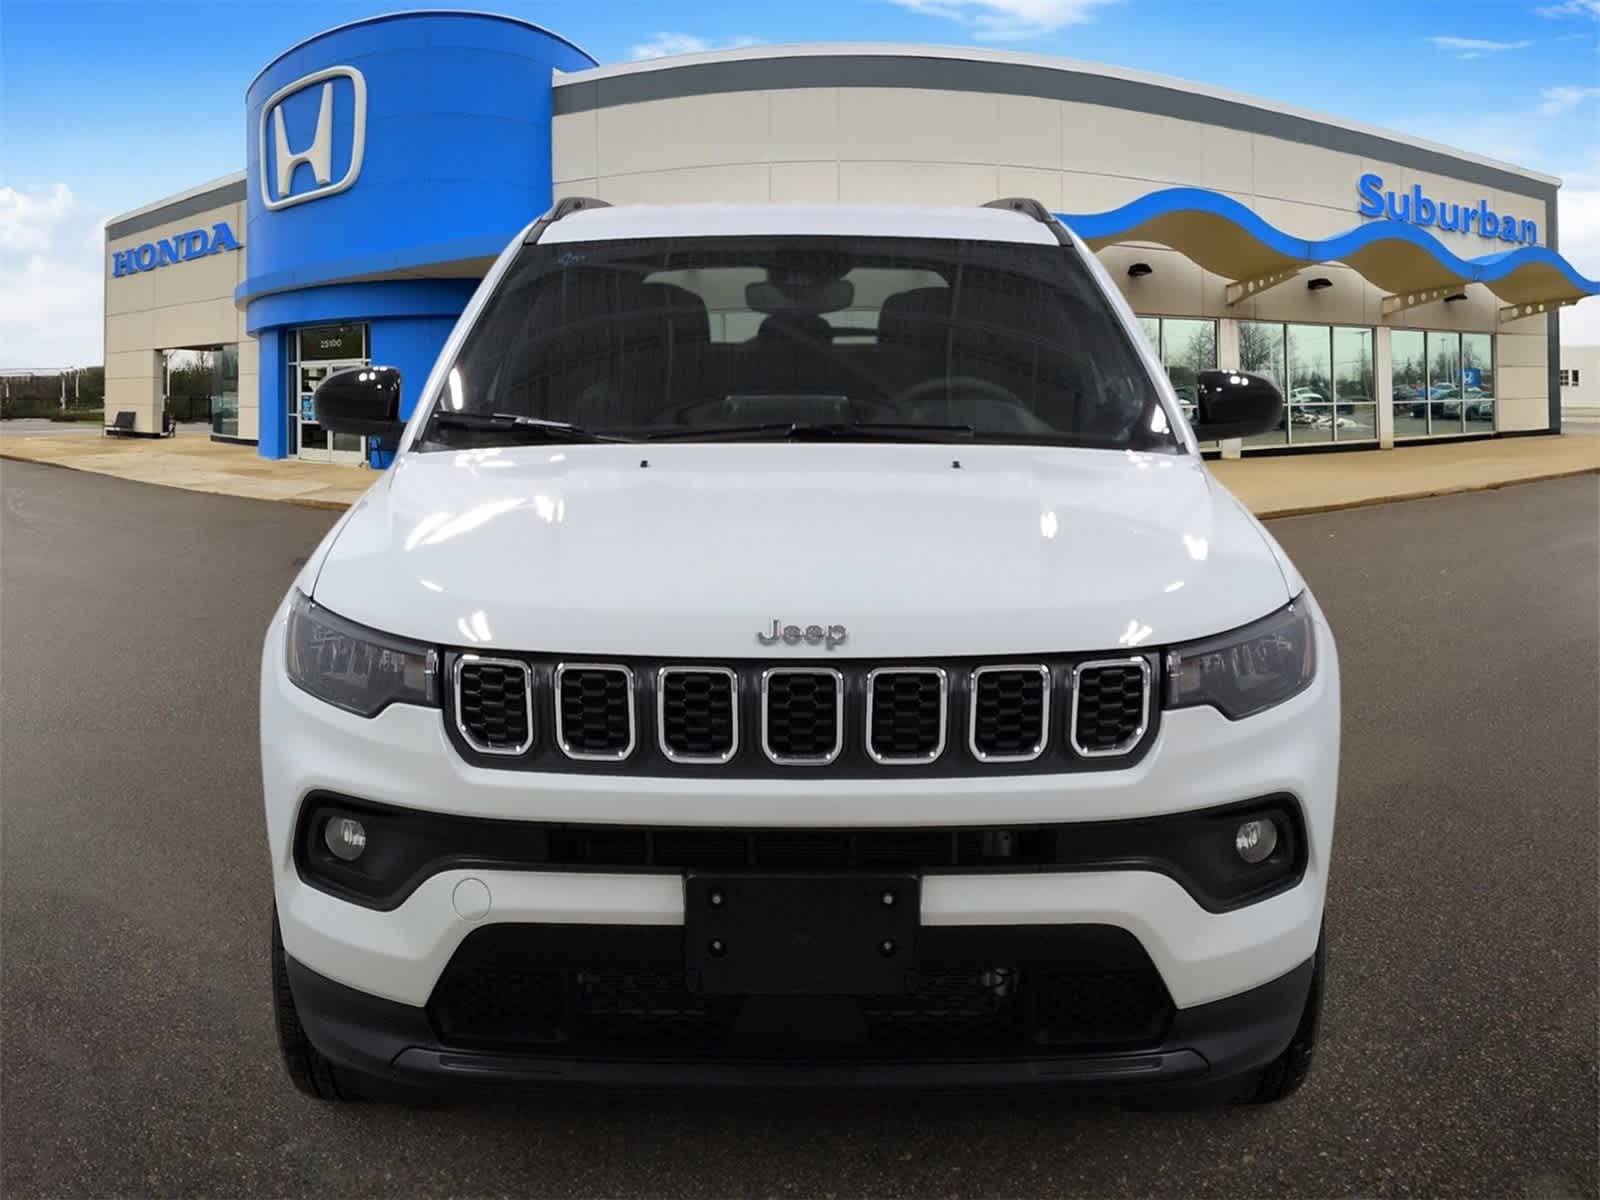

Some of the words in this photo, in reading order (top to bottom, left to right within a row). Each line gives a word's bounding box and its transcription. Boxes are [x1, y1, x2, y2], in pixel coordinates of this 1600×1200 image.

[1358, 173, 1538, 246] Suburban
[112, 221, 240, 278] HONDA
[757, 618, 847, 651] Jeep
